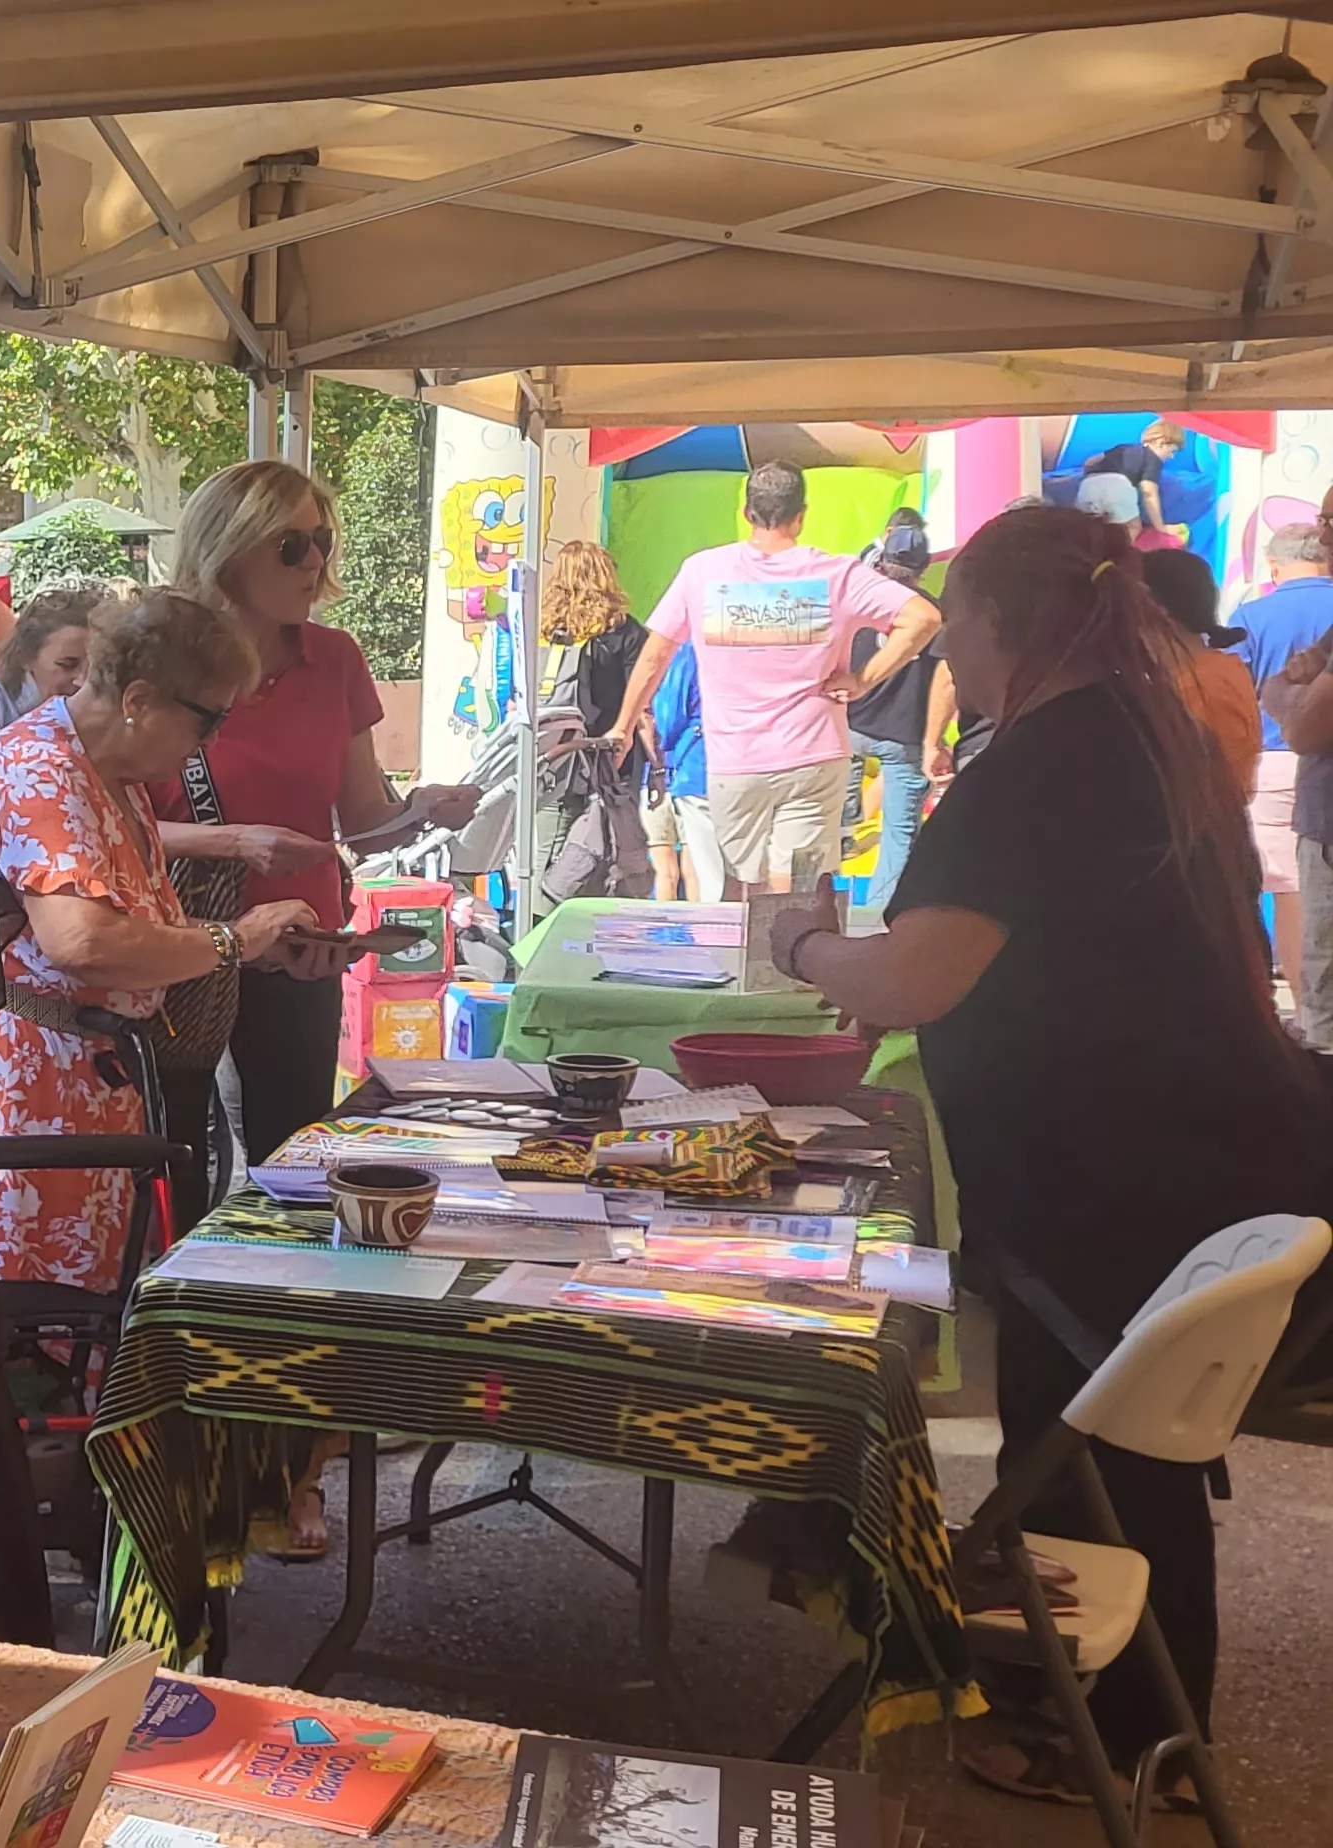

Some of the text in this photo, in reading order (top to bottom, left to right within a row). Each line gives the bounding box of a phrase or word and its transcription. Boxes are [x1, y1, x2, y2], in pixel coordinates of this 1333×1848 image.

[304, 1755, 356, 1803] COMPRA
[771, 1790, 797, 1812] DE
[808, 1774, 835, 1827] AYUDA
